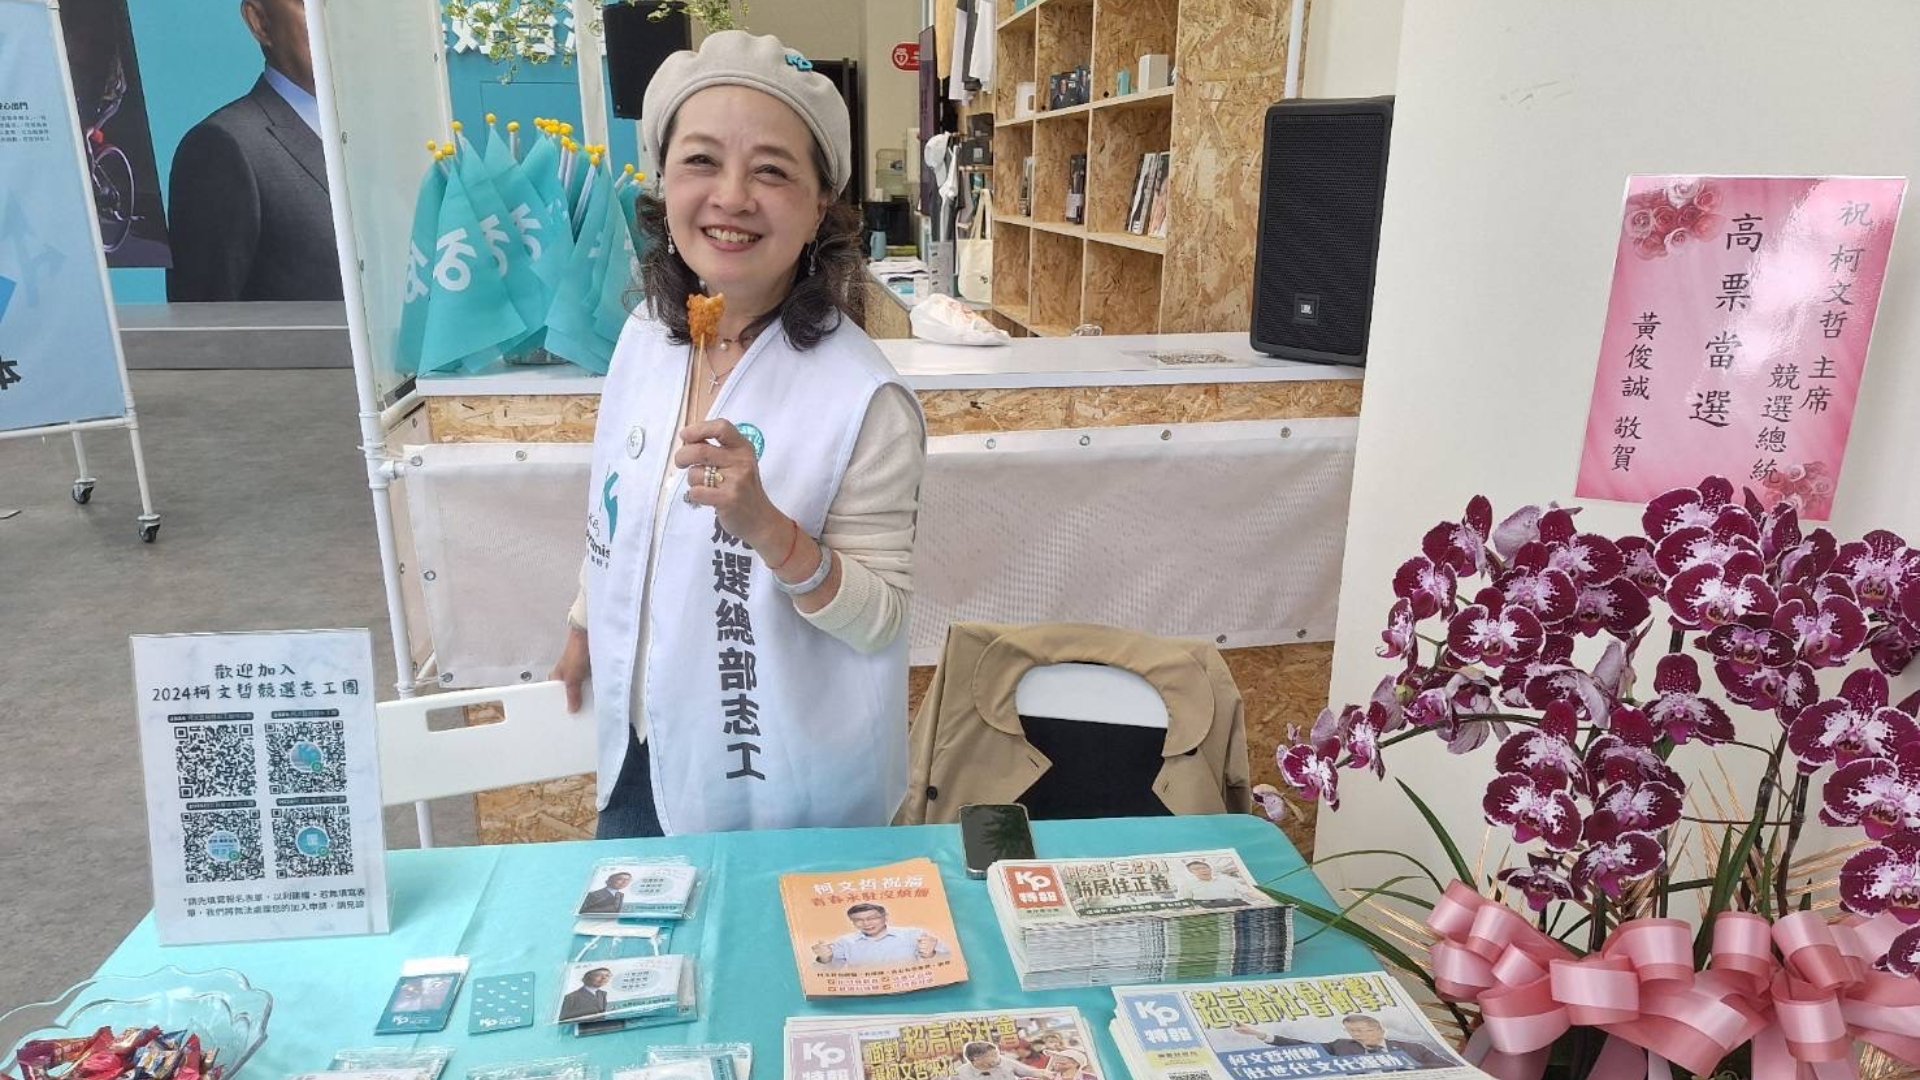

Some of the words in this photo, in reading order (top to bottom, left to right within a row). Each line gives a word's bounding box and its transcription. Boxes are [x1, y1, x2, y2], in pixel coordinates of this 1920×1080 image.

[1841, 202, 1872, 226] 祝
[1689, 213, 1763, 428] 高票當選
[1819, 245, 1866, 339] 柯文哲
[1621, 312, 1662, 400] 黃俊誠
[1799, 356, 1837, 414] 主席
[1611, 416, 1642, 472] 敬賀
[1750, 363, 1800, 484] 競選總統
[152, 680, 360, 701] 2024柯文哲競選志工團
[215, 663, 296, 679] 歡迎加入
